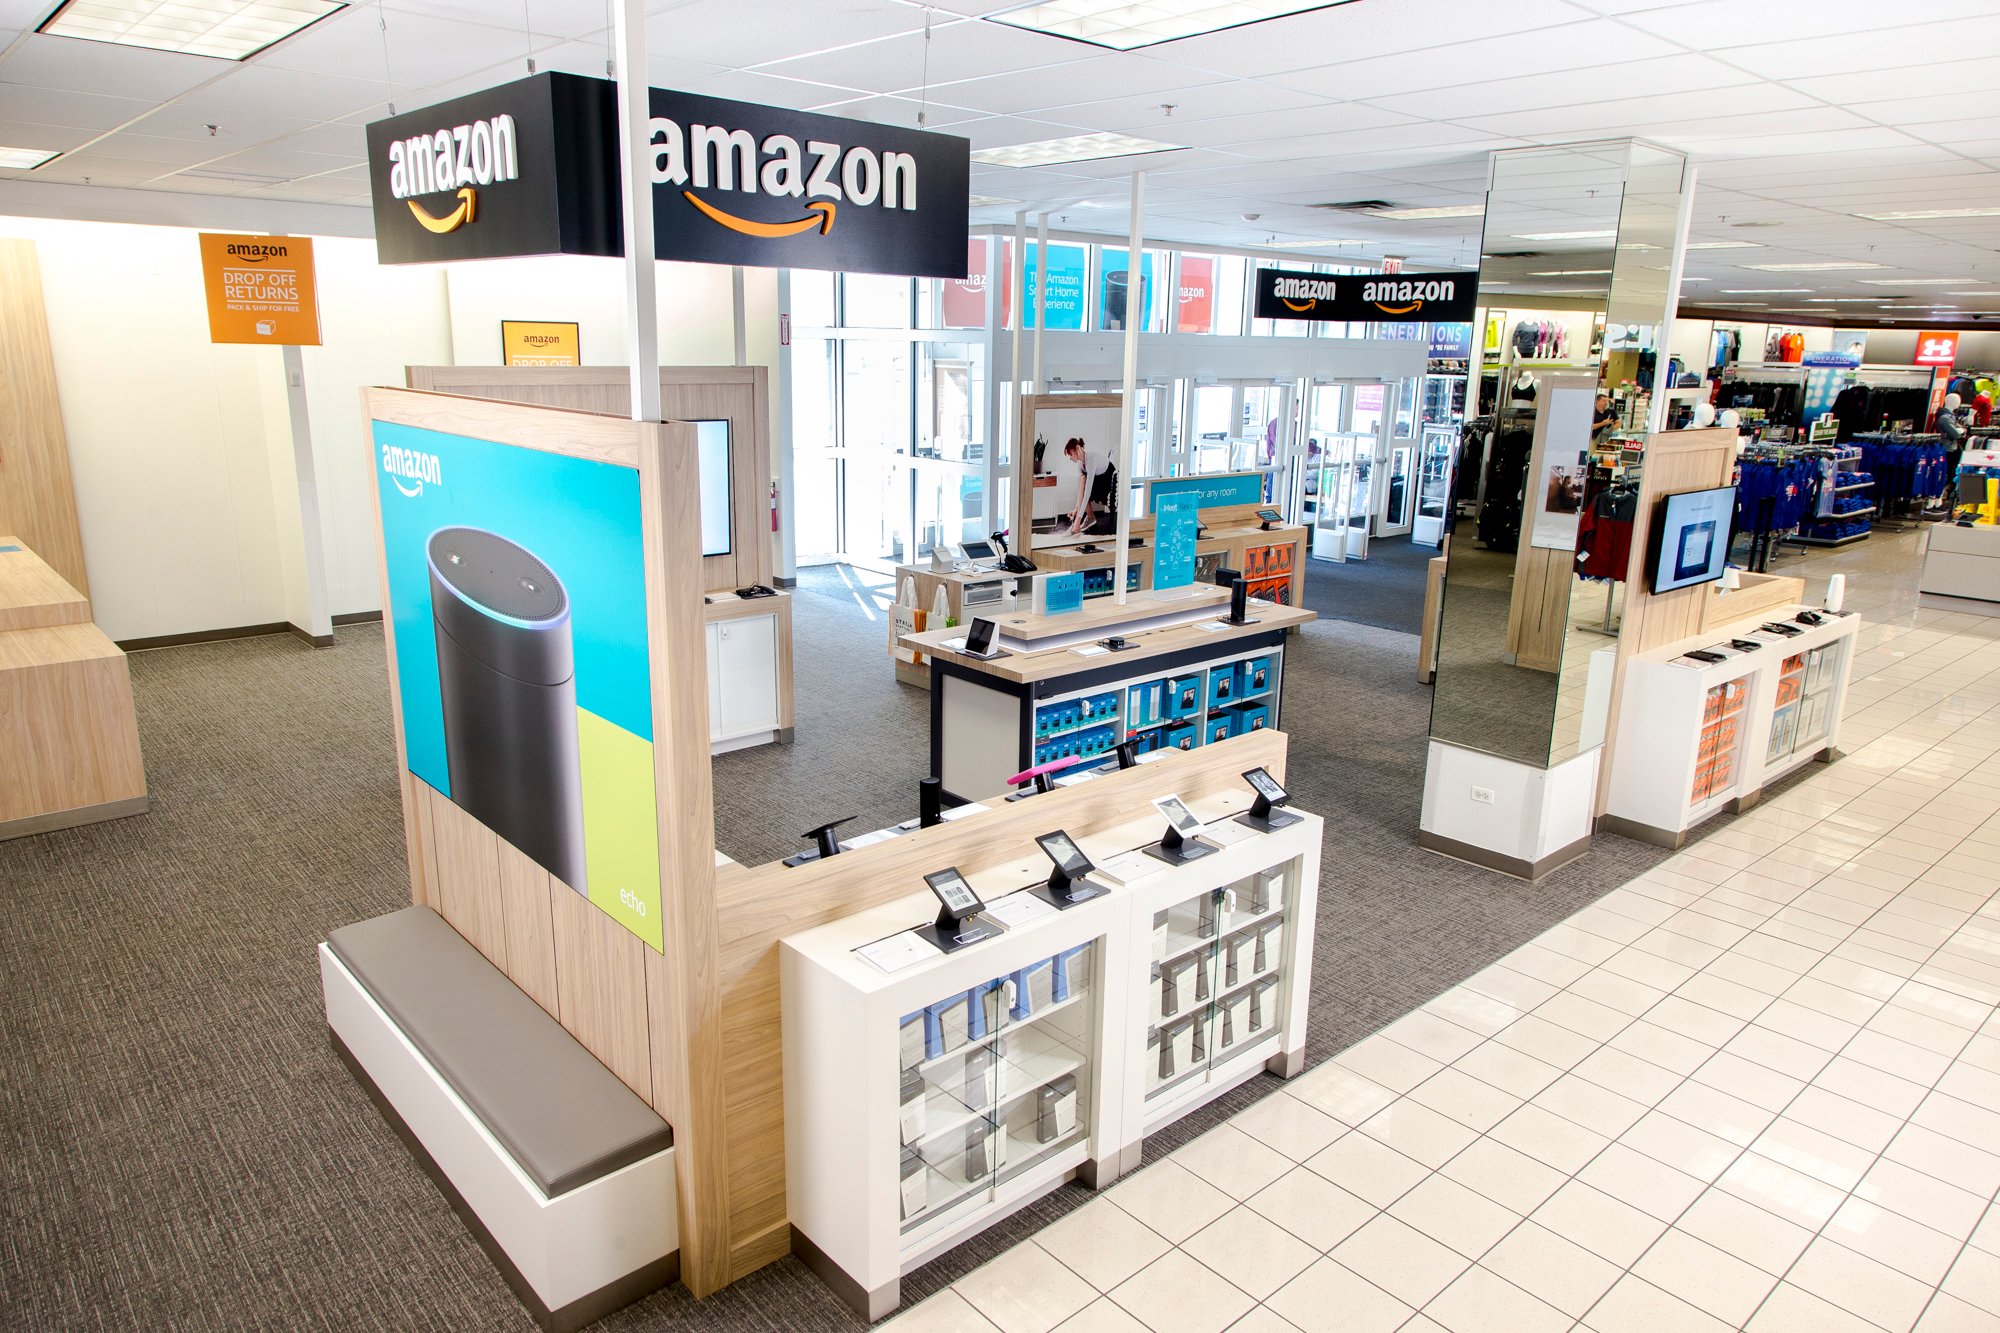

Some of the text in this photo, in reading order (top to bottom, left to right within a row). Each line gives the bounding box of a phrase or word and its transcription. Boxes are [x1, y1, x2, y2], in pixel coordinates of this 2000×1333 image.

[389, 113, 519, 199] amazon
[649, 116, 917, 211] amazon
[227, 243, 287, 257] amazon
[223, 272, 297, 286] DROP OFF
[955, 273, 986, 286] maz
[1046, 272, 1079, 285] Amazon
[224, 285, 299, 300] RETURNS
[1028, 284, 1080, 298] Srt Home
[1179, 286, 1205, 298] azon
[1273, 276, 1337, 301] amazon
[1362, 279, 1455, 302] amazon
[1032, 297, 1075, 310] Eerience
[524, 335, 560, 344] amazon
[512, 359, 547, 367] DROP
[382, 443, 443, 487] amazon
[1206, 490, 1219, 500] any
[1219, 487, 1237, 497] room
[1163, 503, 1178, 512] Meet
[620, 887, 646, 918] echo
